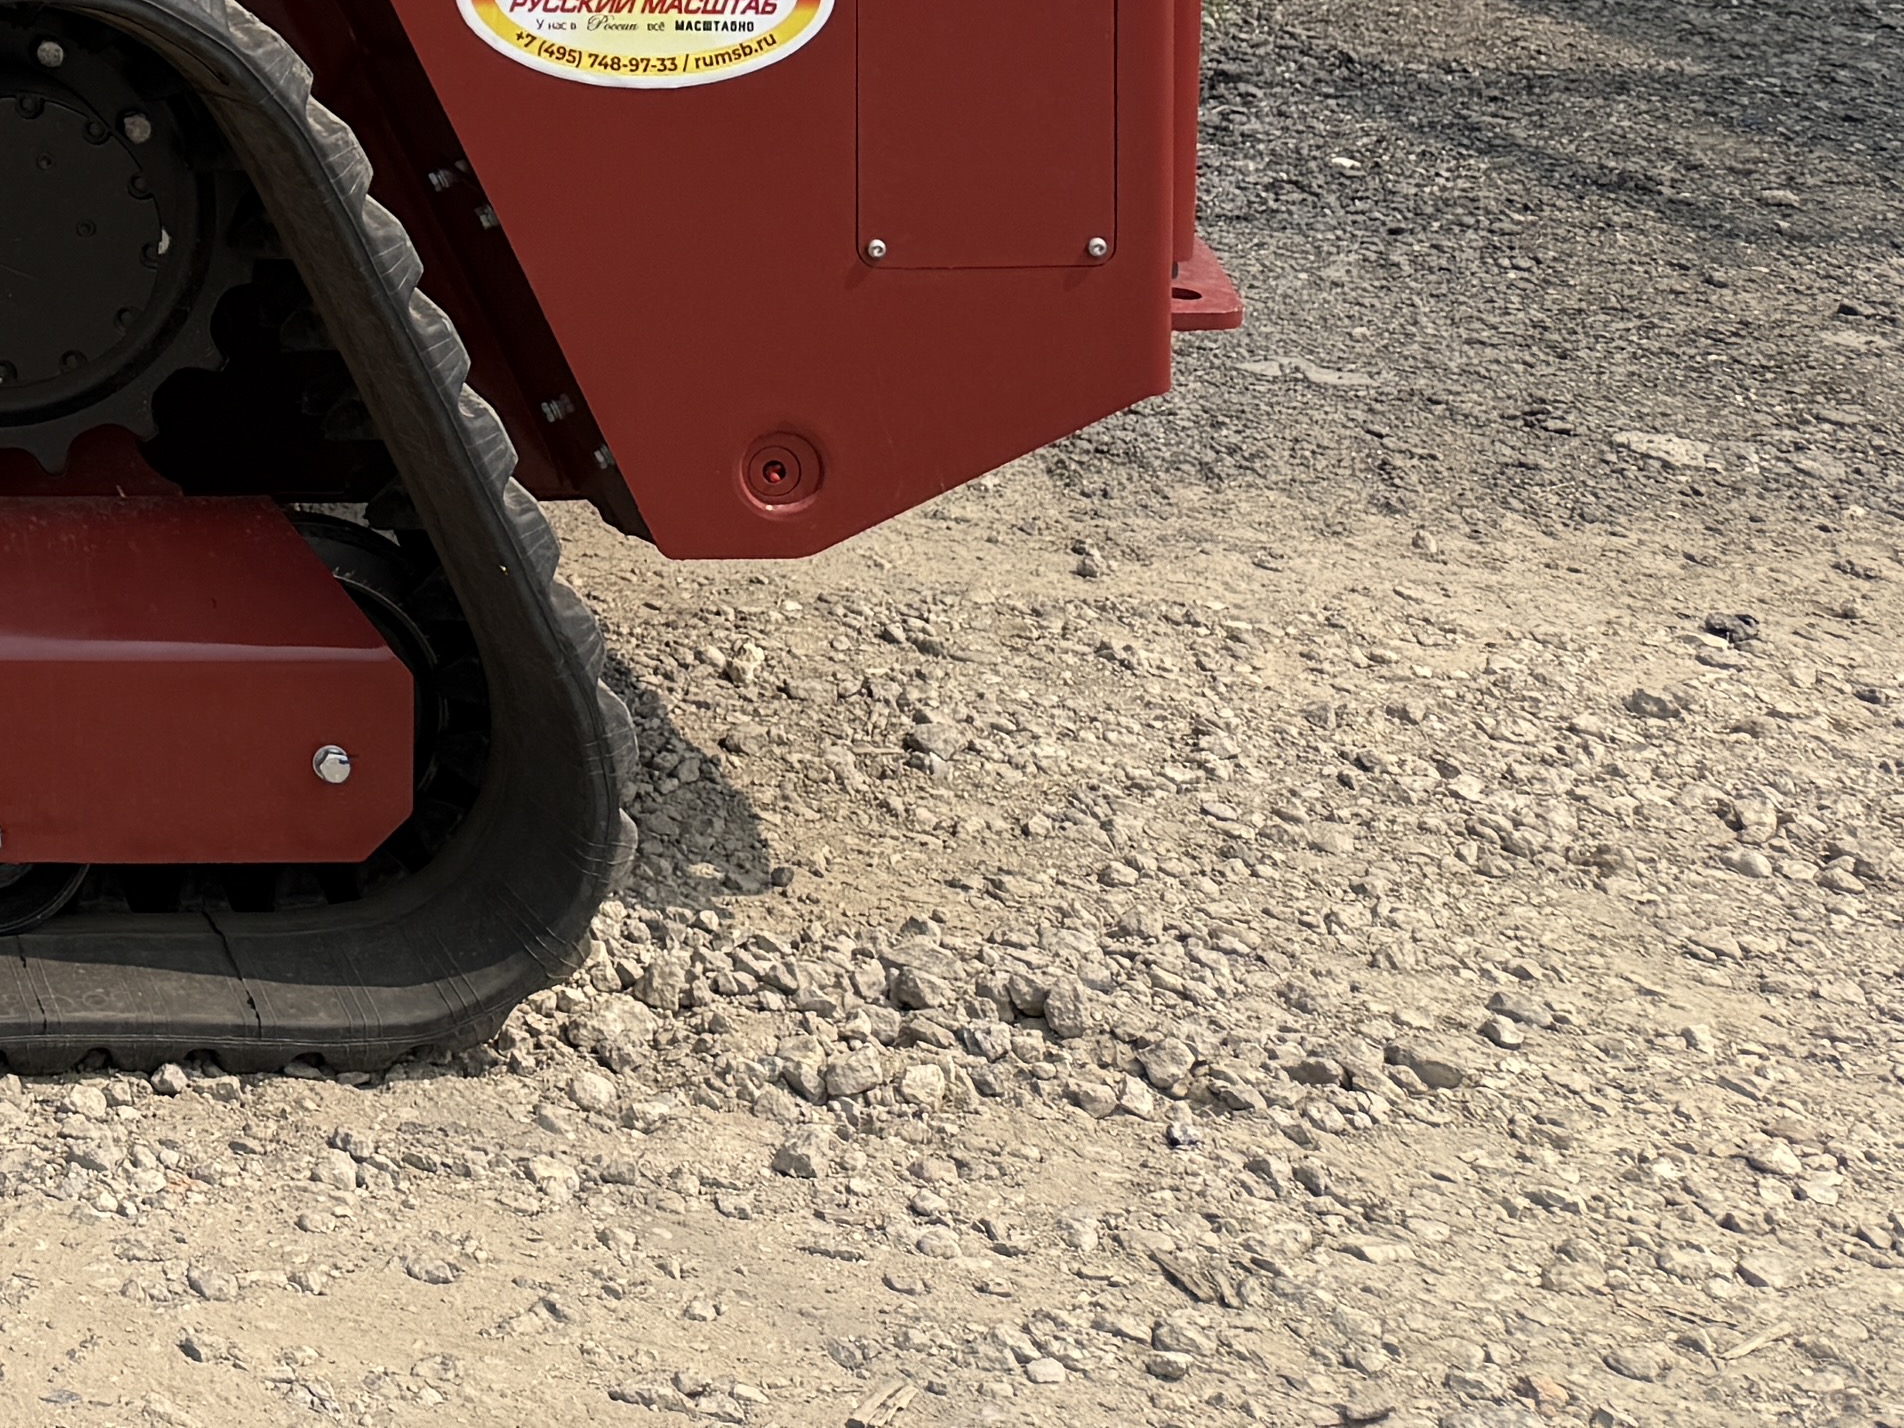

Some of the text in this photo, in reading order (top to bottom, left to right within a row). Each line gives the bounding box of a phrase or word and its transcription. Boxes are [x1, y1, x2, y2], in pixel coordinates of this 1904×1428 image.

[515, 30, 537, 49] +7
[537, 40, 583, 68] (495)
[588, 53, 678, 73] 748-97-33
[694, 33, 778, 70] rumsb.ru
